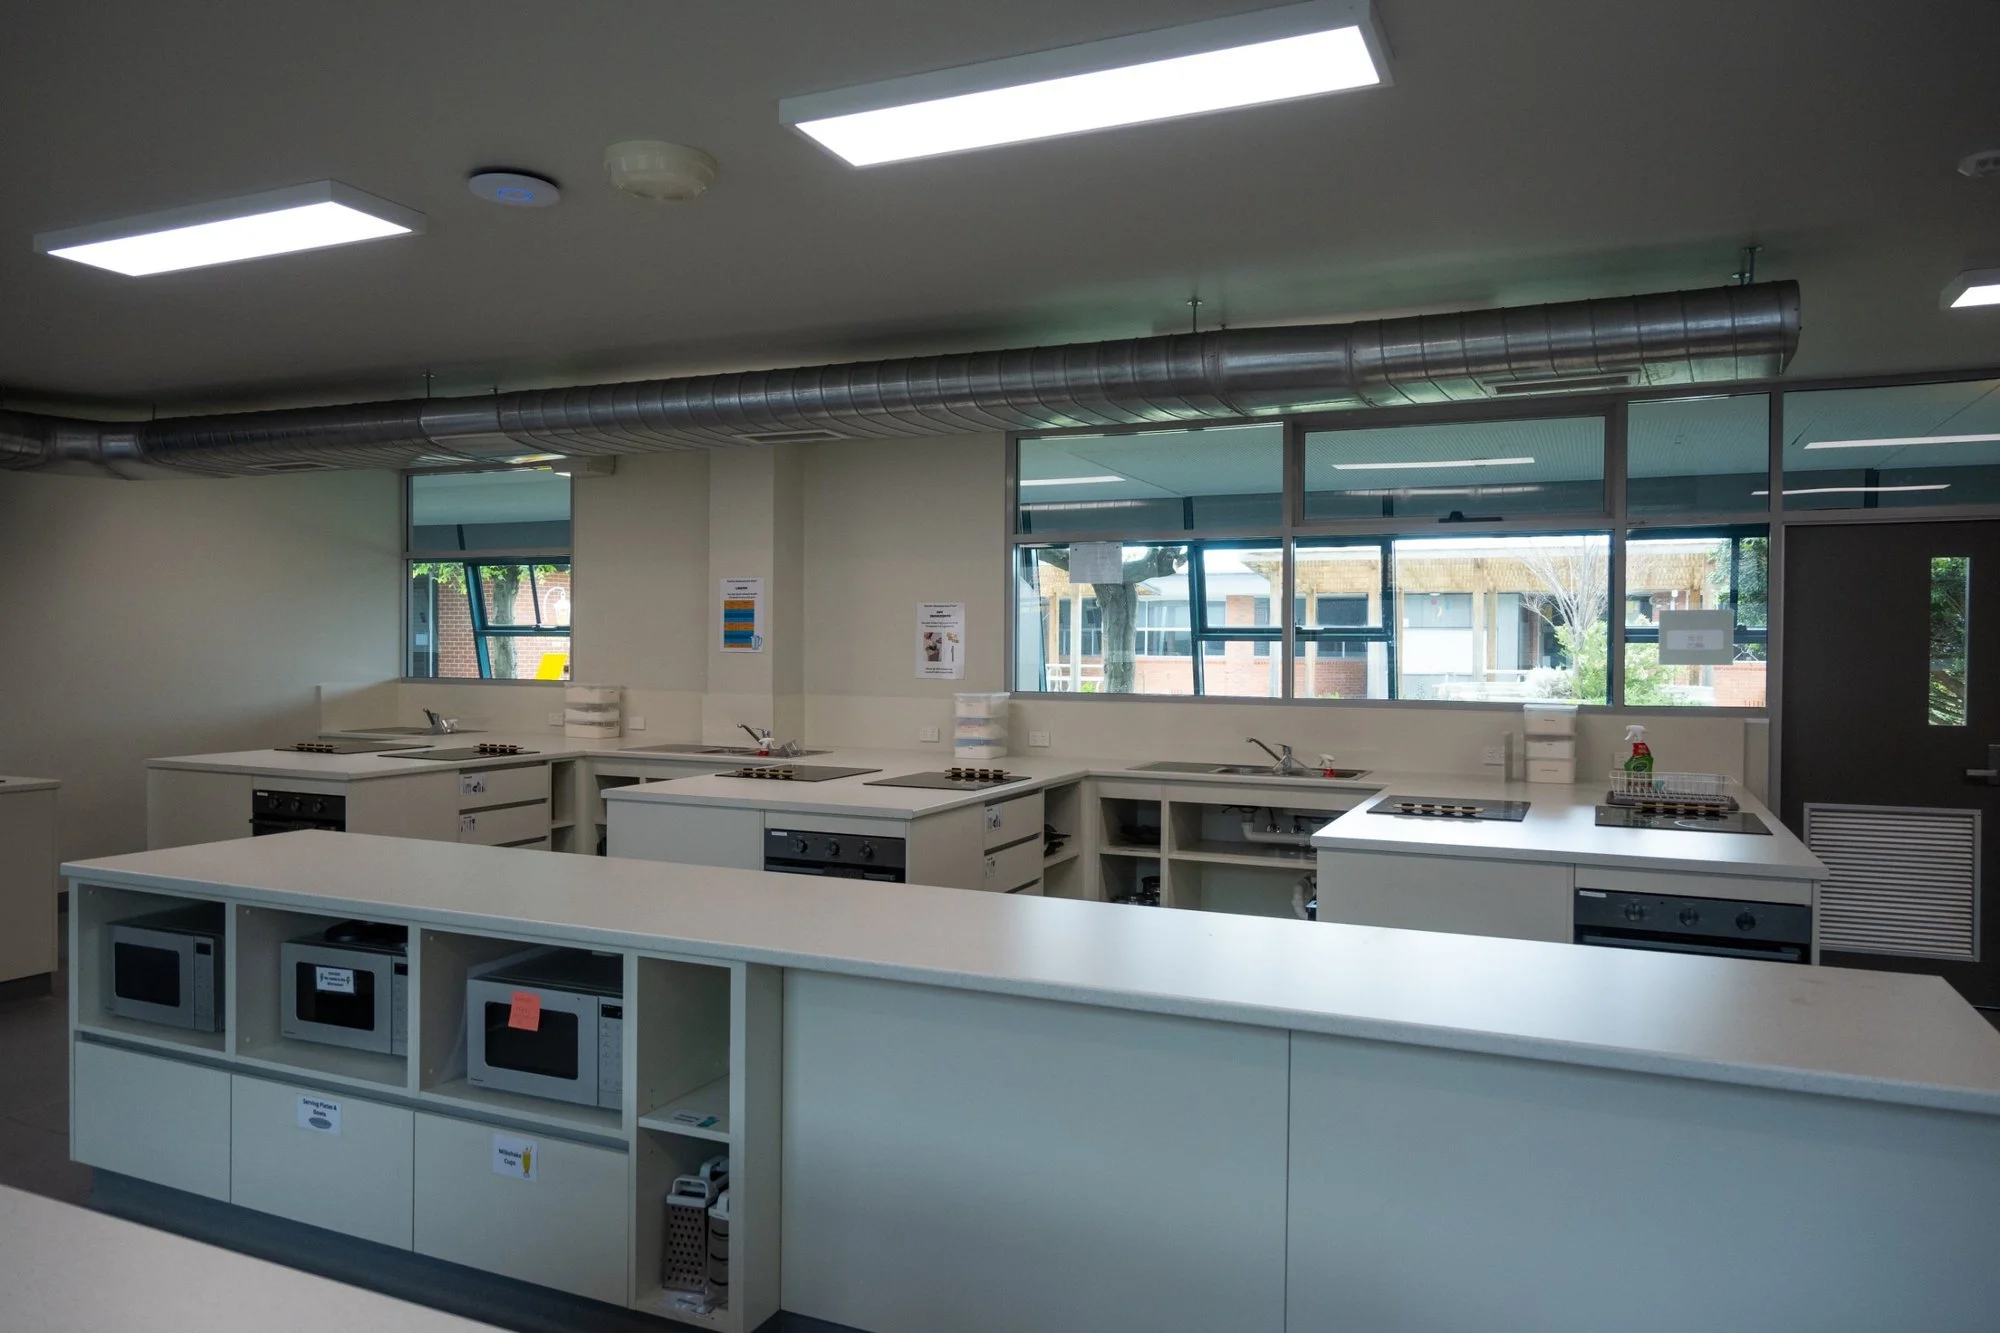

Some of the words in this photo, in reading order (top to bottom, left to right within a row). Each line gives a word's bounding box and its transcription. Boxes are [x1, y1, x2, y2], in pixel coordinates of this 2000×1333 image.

[303, 1098, 319, 1108] Serving
[498, 1148, 521, 1159] Milkshake
[504, 1158, 516, 1167] Cups
